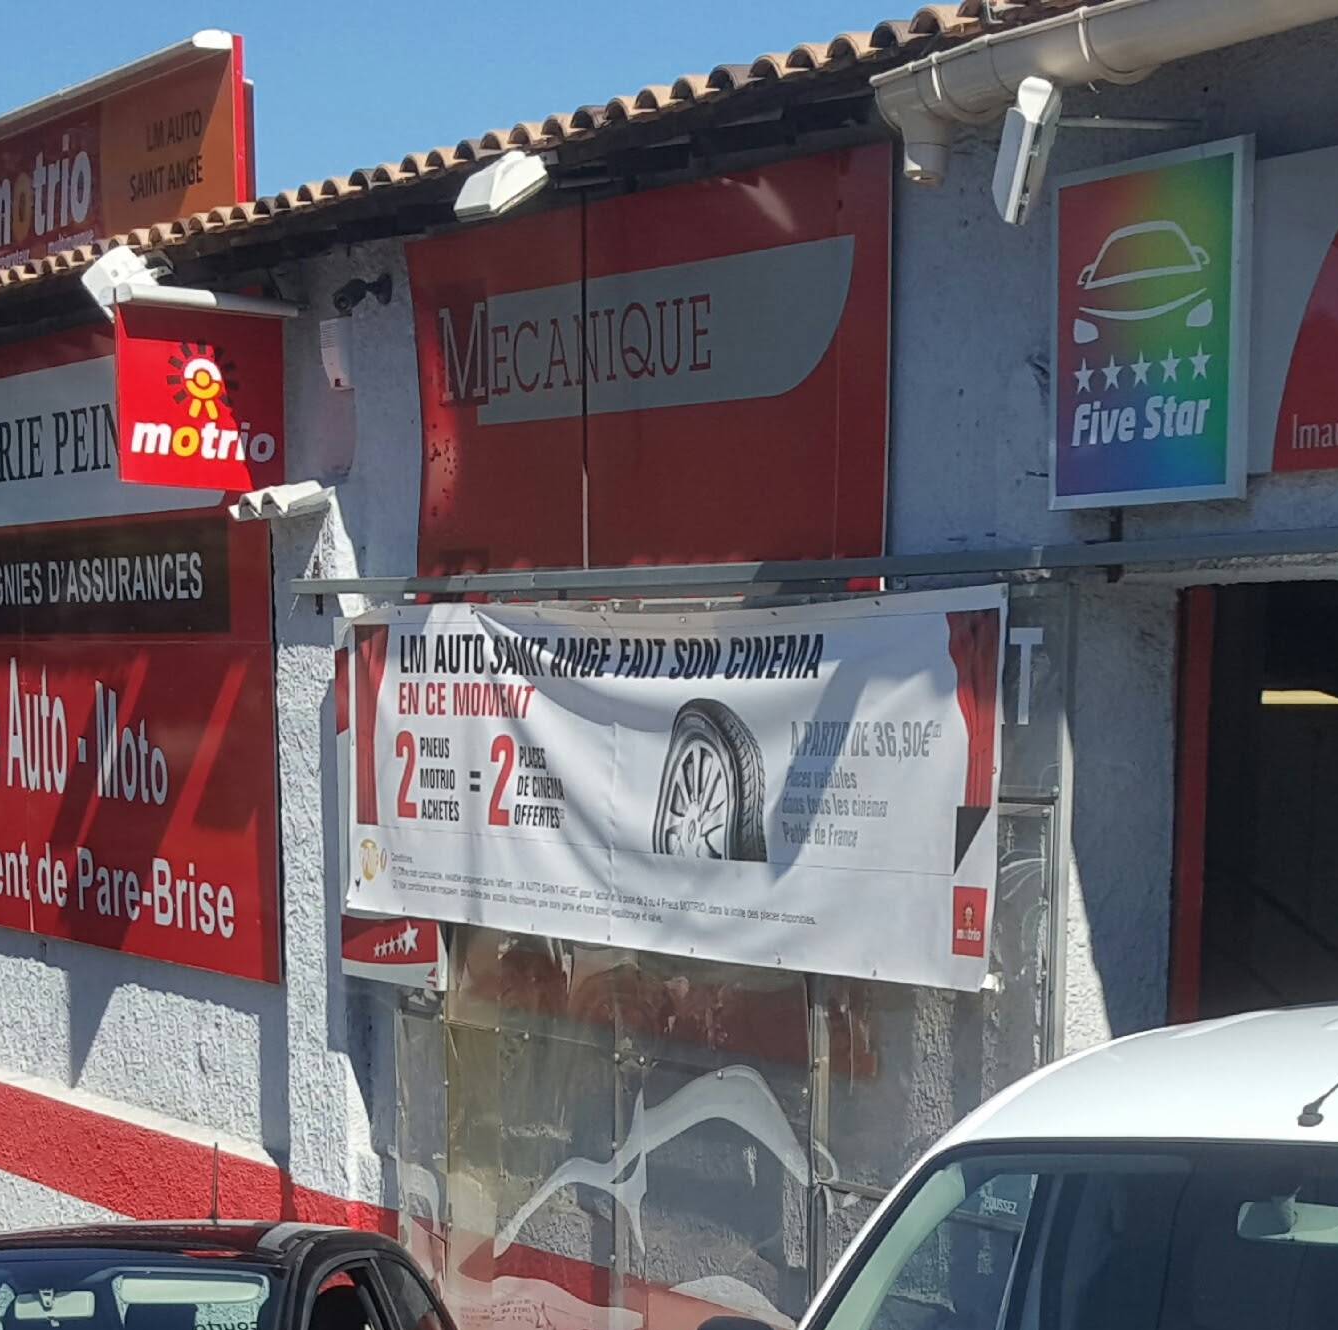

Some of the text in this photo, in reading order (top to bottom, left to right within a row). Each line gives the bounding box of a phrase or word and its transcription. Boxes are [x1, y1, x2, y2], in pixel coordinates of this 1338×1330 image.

[146, 109, 202, 152] LM AUTO
[129, 155, 204, 201] SAINT ANGE
[438, 293, 712, 404] MECANIQUE
[131, 420, 276, 463] motrio
[1071, 395, 1212, 447] Five Star
[47, 551, 204, 604] D'ASSURANCES
[400, 633, 824, 680] LM AUTO SAINT ANGE FAIT SON CINEMA
[398, 681, 536, 719] EN CE MOMENT
[6, 656, 68, 795] Auto
[95, 680, 169, 806] Moto
[419, 736, 451, 758] PNEUS
[803, 720, 851, 757] PARTIR
[850, 721, 871, 757] DE
[395, 730, 418, 819] 2
[419, 768, 456, 790] MOTRIO
[518, 745, 547, 770] PLACES
[488, 734, 515, 827] 2
[516, 775, 530, 797] DE
[421, 795, 460, 822] ACHETÉS
[833, 794, 850, 816] les
[814, 821, 826, 845] de
[828, 823, 859, 848] France
[37, 842, 67, 907] de
[77, 845, 235, 940] Pare-Brise
